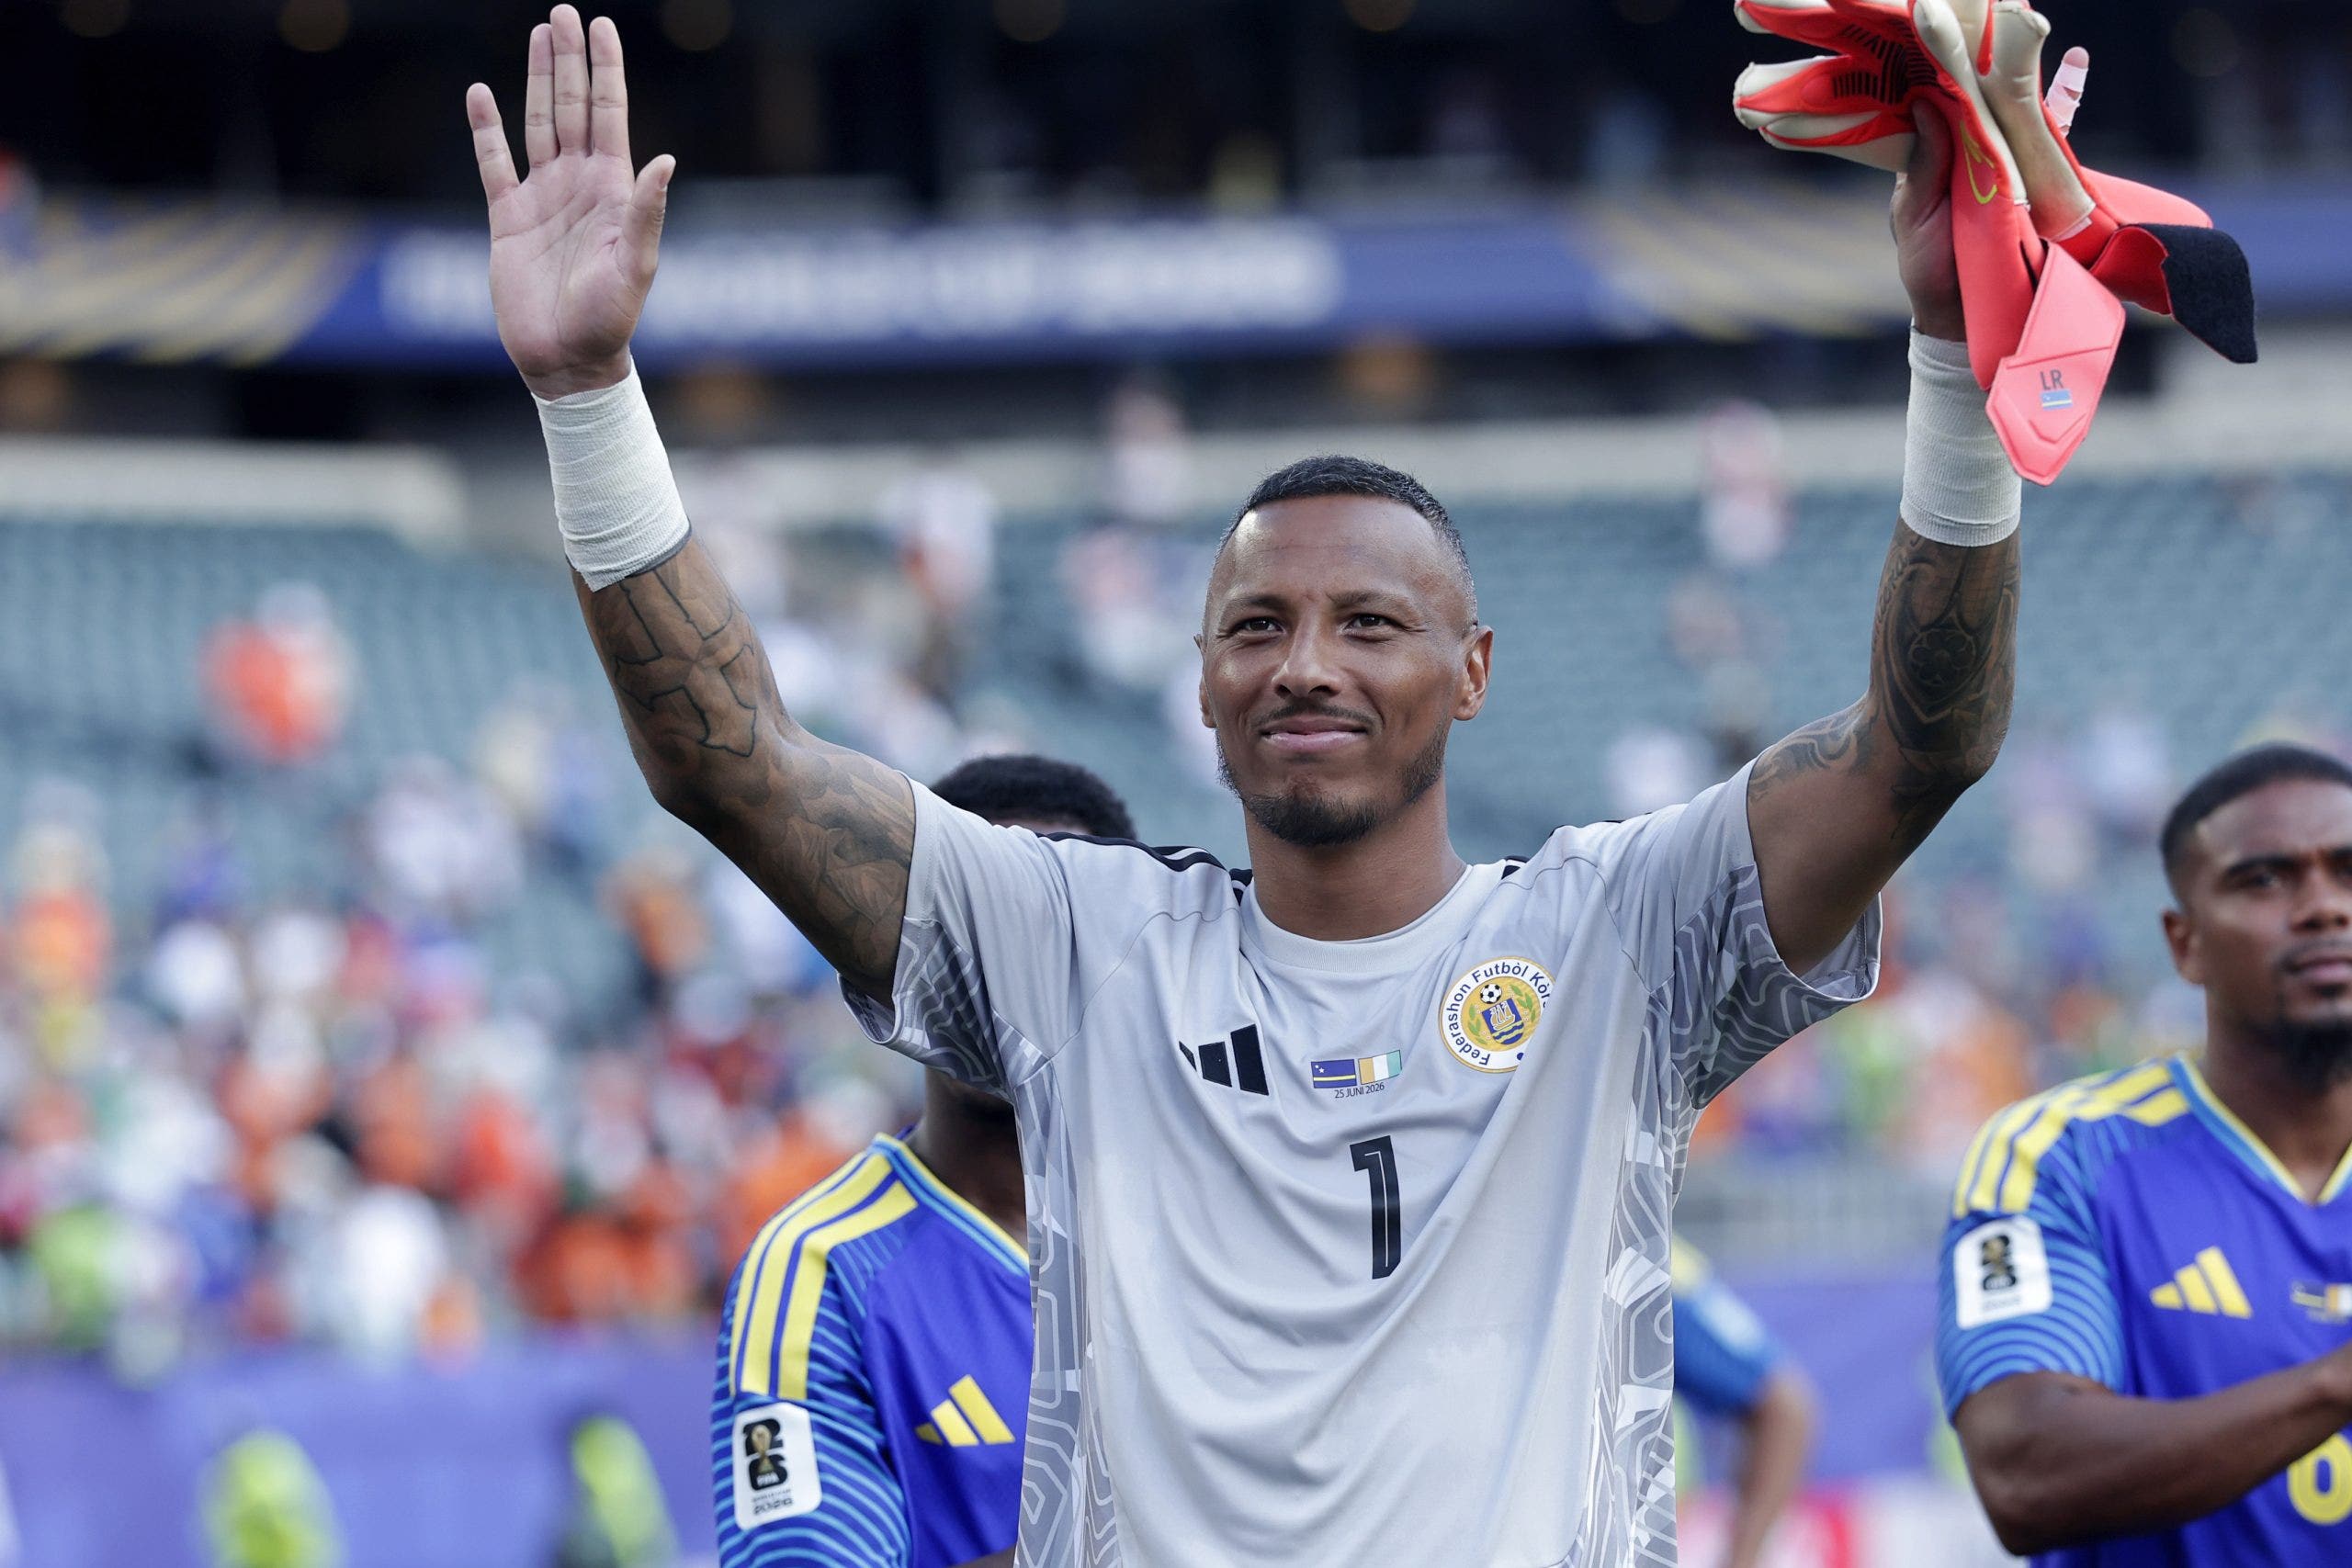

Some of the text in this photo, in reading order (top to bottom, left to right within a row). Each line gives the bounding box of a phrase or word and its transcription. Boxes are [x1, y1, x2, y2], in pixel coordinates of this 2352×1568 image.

[2040, 369, 2064, 390] LR
[1446, 983, 1491, 1066] Federashon
[1472, 962, 1529, 983] Futbòl
[1334, 1082, 1385, 1099] 25 JUNI 2026
[1350, 1135, 1401, 1280] 1
